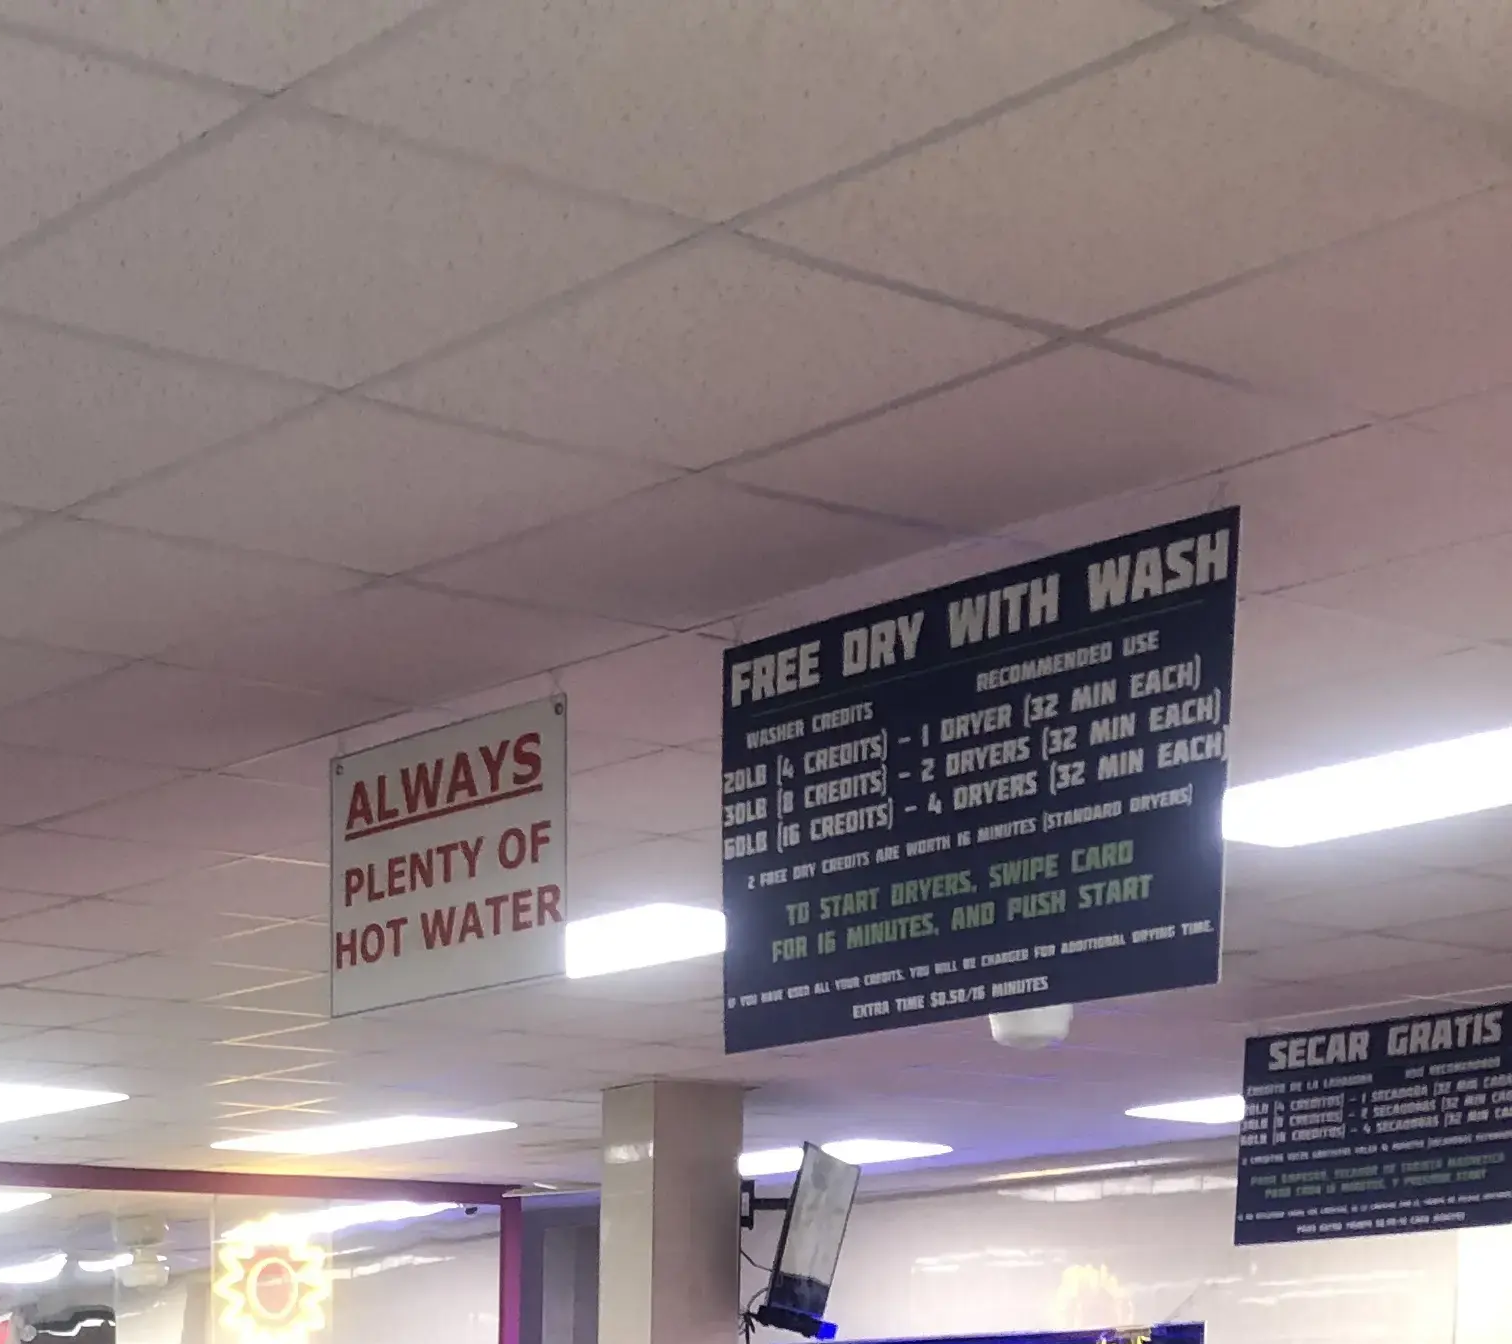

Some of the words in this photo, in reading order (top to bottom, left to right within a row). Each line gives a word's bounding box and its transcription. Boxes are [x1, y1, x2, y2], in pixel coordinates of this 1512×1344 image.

[731, 640, 820, 708] FREE
[842, 610, 923, 678] DRY
[948, 573, 1060, 648] WITH
[1087, 528, 1230, 613] WASH
[976, 640, 1113, 692] RECOMMENDED
[1122, 630, 1160, 657] USE
[724, 764, 767, 794] 20LB
[777, 755, 795, 786] (4
[804, 727, 888, 775] CREDITS)
[921, 723, 929, 747] 1
[941, 703, 1013, 743] DRYER
[1023, 693, 1059, 728] (32
[1071, 679, 1117, 713] MIN
[1131, 653, 1202, 699] EACH)
[724, 798, 767, 828] 30LB
[777, 788, 794, 819] (8
[804, 763, 888, 809] CREDITS)
[920, 758, 936, 783] 2
[946, 736, 1031, 778] DRYERS
[1041, 725, 1077, 760] (32
[1090, 713, 1135, 746] MIN
[1149, 688, 1222, 732] EACH)
[746, 719, 805, 749] WASHER
[812, 702, 874, 732] CREDITS
[346, 732, 542, 831] ALWAYS
[777, 821, 801, 853] (16
[810, 797, 894, 842] CREDITS)
[927, 792, 942, 815] 4
[954, 770, 1037, 810] DRYERS
[1050, 760, 1085, 795] (32
[1098, 748, 1143, 781] MIN
[1158, 725, 1229, 769] EACH)
[345, 835, 484, 907] PLENTY
[498, 820, 551, 869] OF
[787, 902, 810, 926] TO
[820, 887, 880, 920] START
[988, 854, 1059, 889] SWIPE
[1071, 840, 1134, 874] CARD
[793, 862, 817, 881] DRY
[977, 818, 1036, 844] MINUTES
[336, 917, 409, 970] HOT
[420, 883, 563, 950] WATER
[772, 935, 808, 963] FOR
[817, 930, 836, 955] 16
[951, 901, 995, 931] AND
[1007, 889, 1066, 922] PUSH
[1078, 874, 1153, 909] START
[1268, 1030, 1370, 1072] SECAR
[1388, 1011, 1503, 1056] GRATIS
